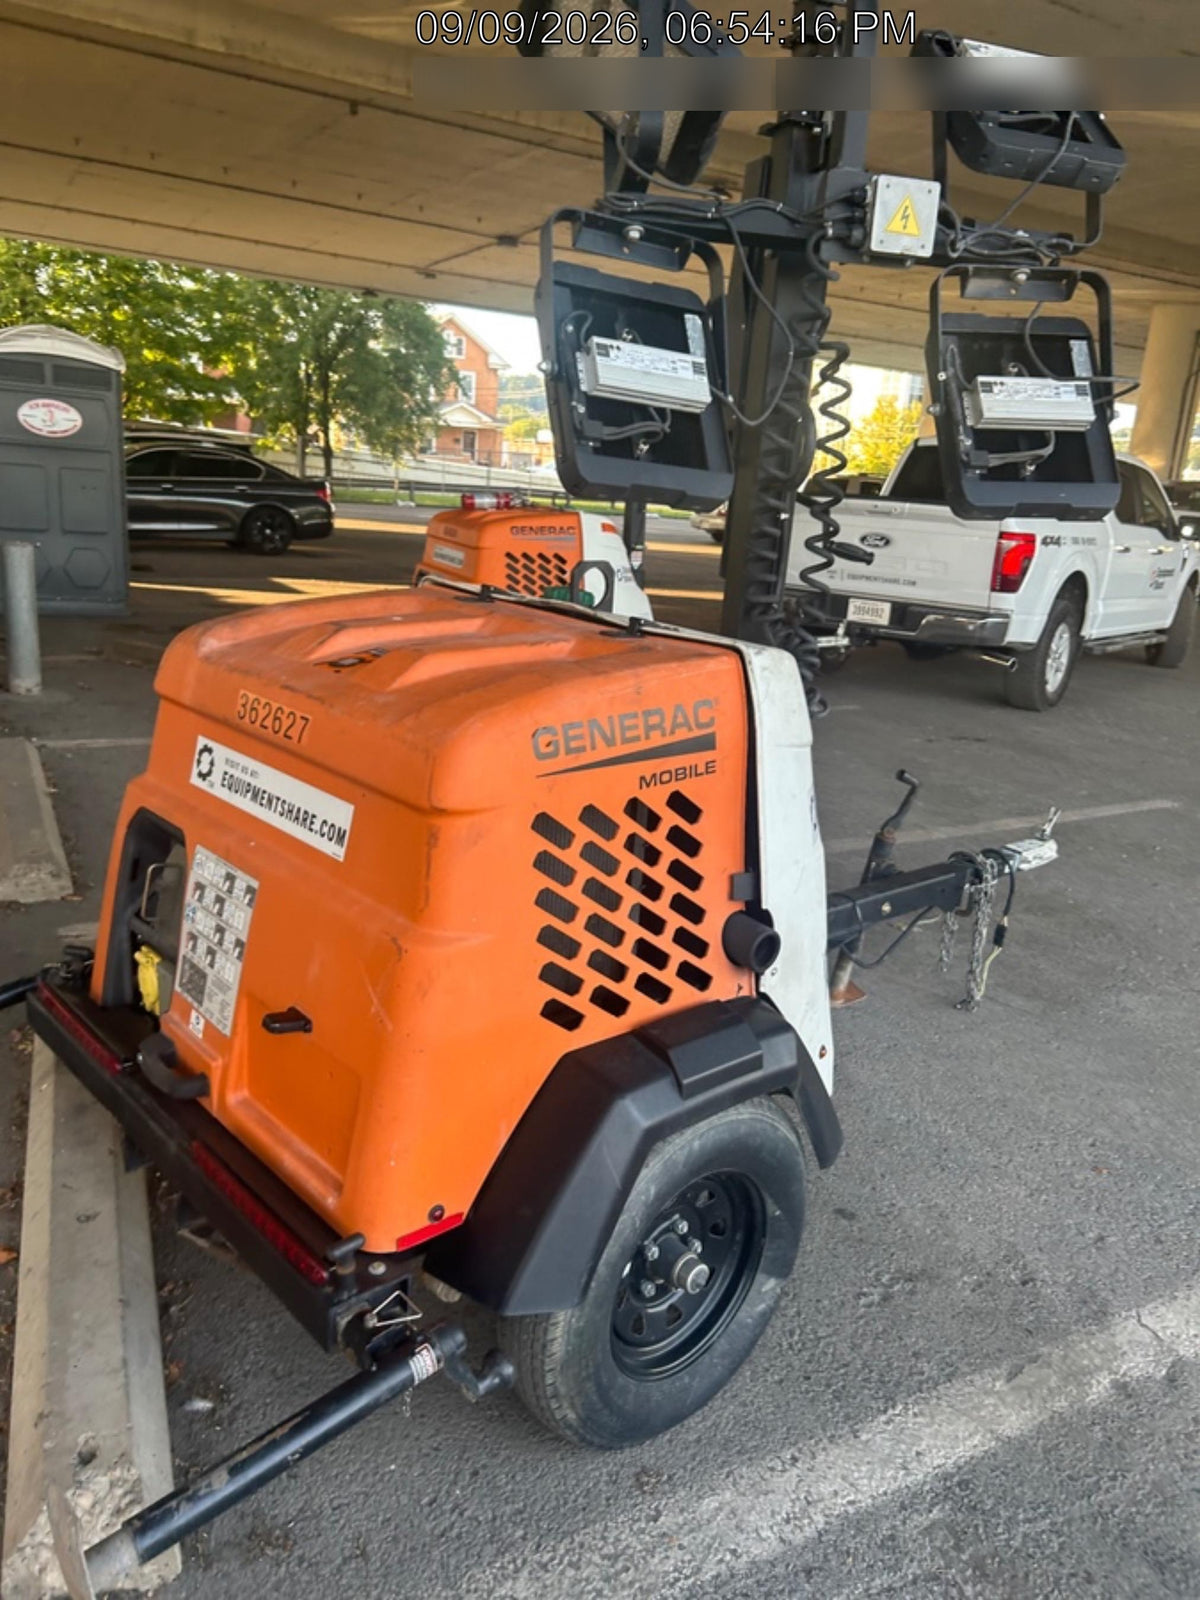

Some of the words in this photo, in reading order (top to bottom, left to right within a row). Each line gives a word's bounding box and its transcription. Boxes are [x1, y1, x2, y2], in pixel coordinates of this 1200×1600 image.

[510, 526, 576, 535] GENERAC
[237, 692, 310, 744] 362627
[532, 699, 716, 761] GENERAC
[639, 760, 716, 790] MOBILE
[219, 771, 347, 848] EQUIPMENTSHARE.COM
